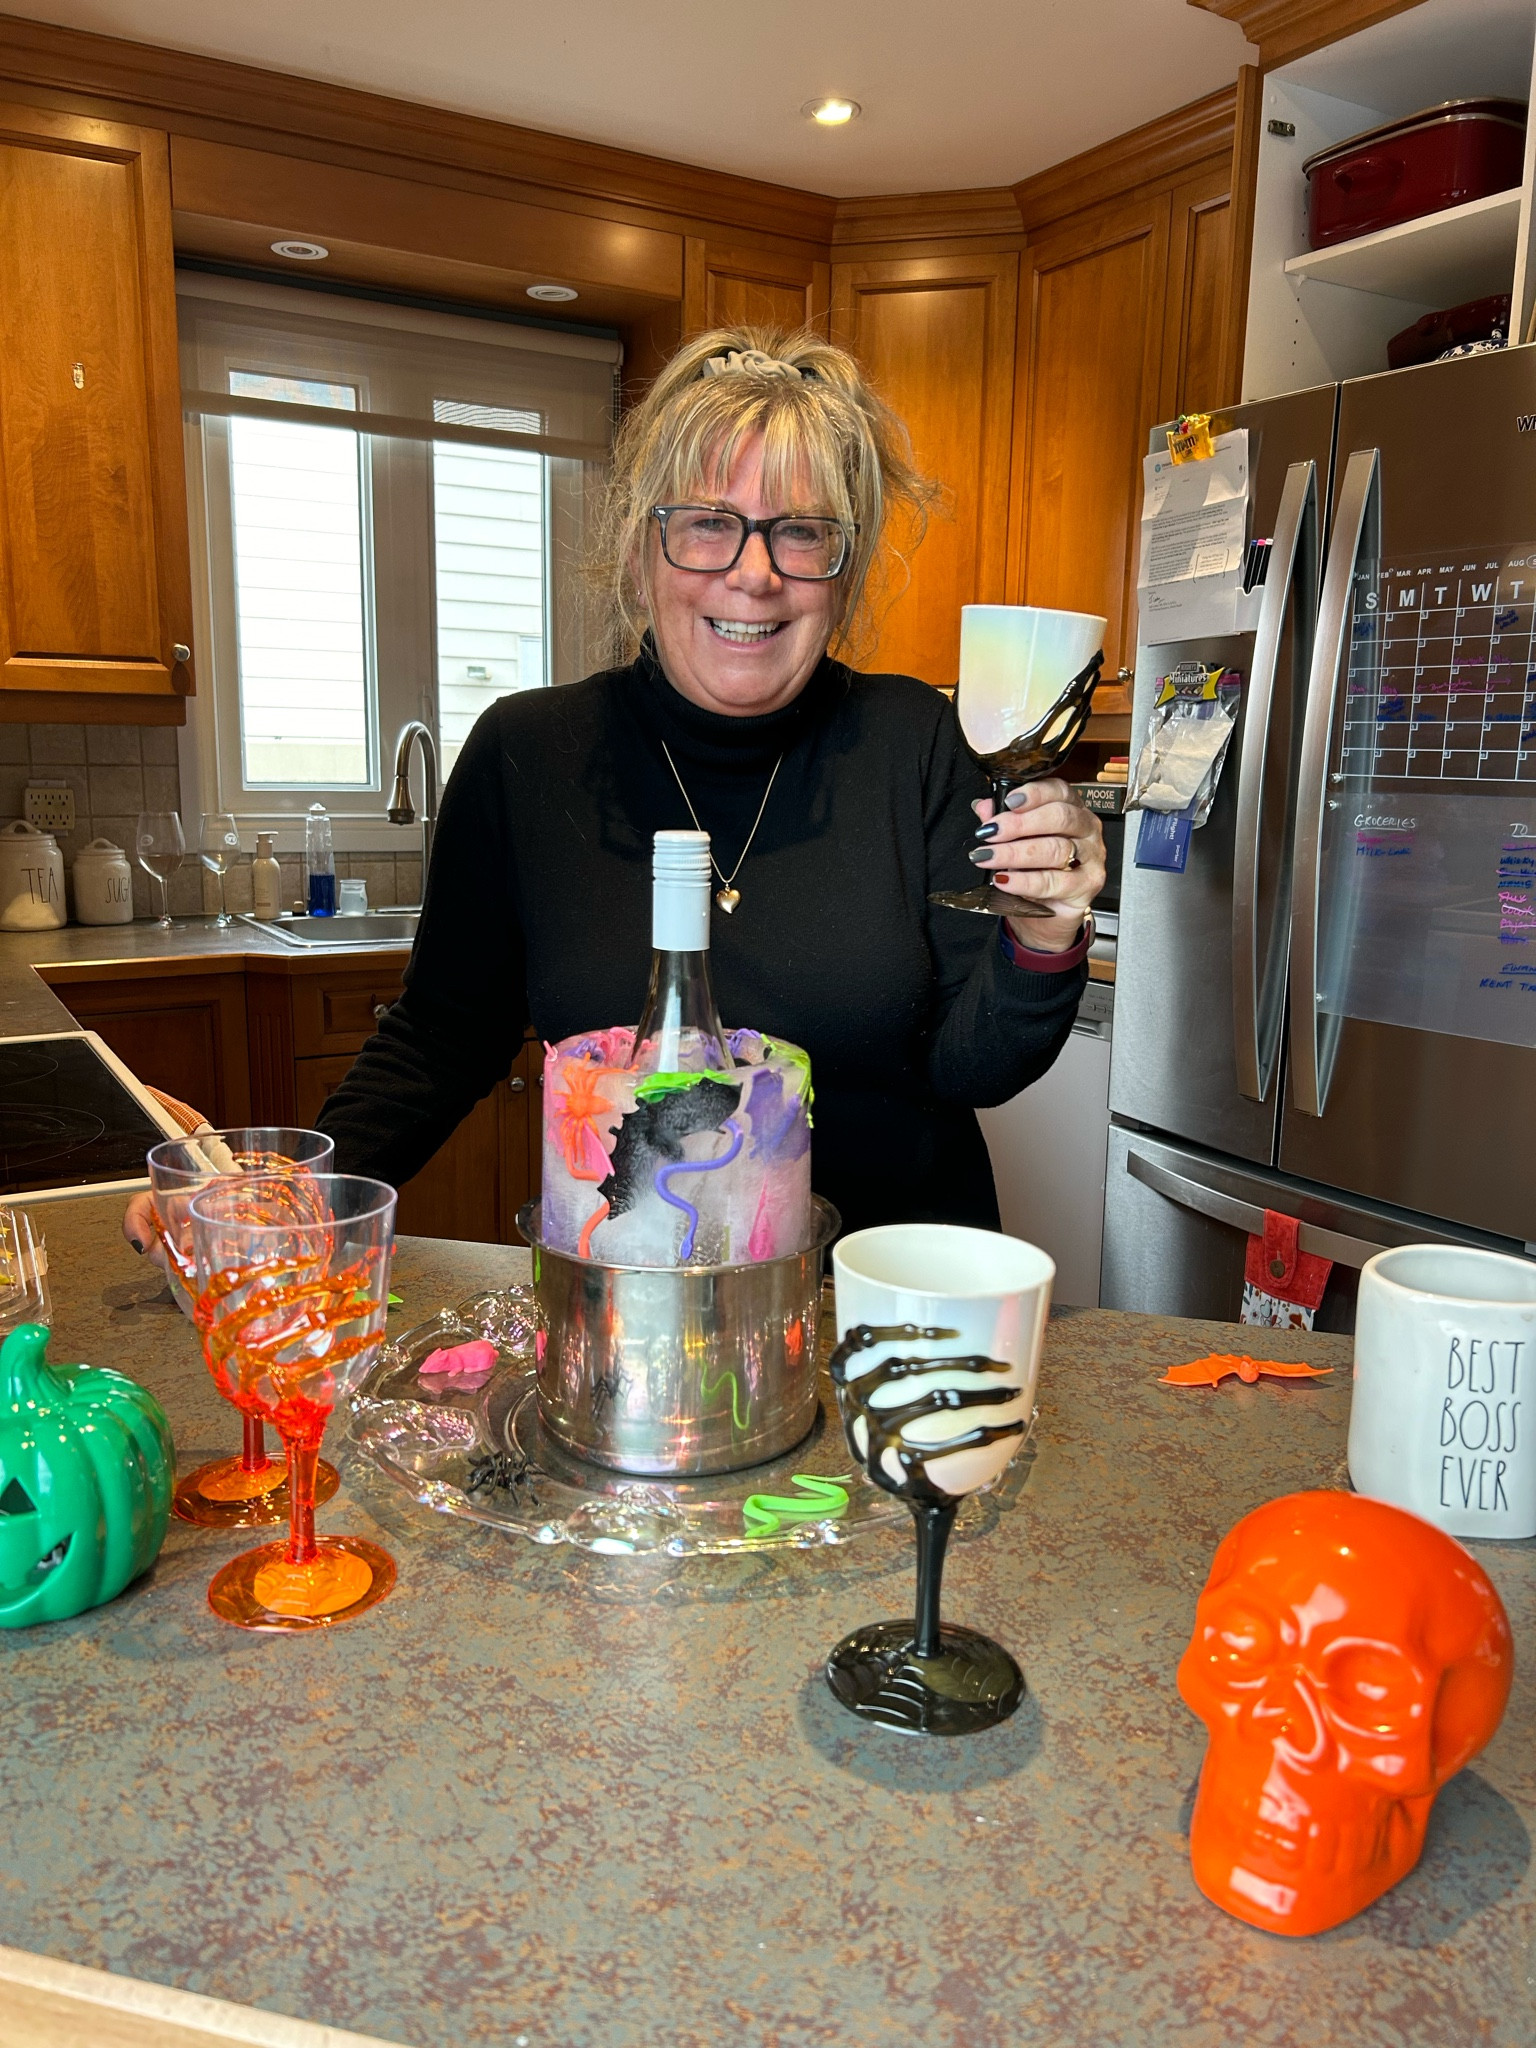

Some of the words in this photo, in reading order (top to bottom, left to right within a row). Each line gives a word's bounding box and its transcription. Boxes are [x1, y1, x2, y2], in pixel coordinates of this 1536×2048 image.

[1357, 573, 1370, 581] JAN
[1417, 568, 1432, 576] APR
[1484, 562, 1499, 570] JUL
[1508, 559, 1525, 568] AUG
[1365, 592, 1378, 610] S
[1399, 589, 1415, 607] M
[1434, 586, 1448, 605] T
[1471, 583, 1493, 602] W
[1510, 580, 1524, 599] T
[1086, 789, 1115, 800] MOOSE
[1092, 800, 1102, 809] THE
[1102, 801, 1115, 809] LOOSE
[1354, 814, 1416, 829] GROCERIES
[21, 867, 59, 904] TEA
[1448, 1336, 1525, 1395] BEST
[1440, 1397, 1521, 1453] BOSS
[1440, 1455, 1508, 1512] EVER
